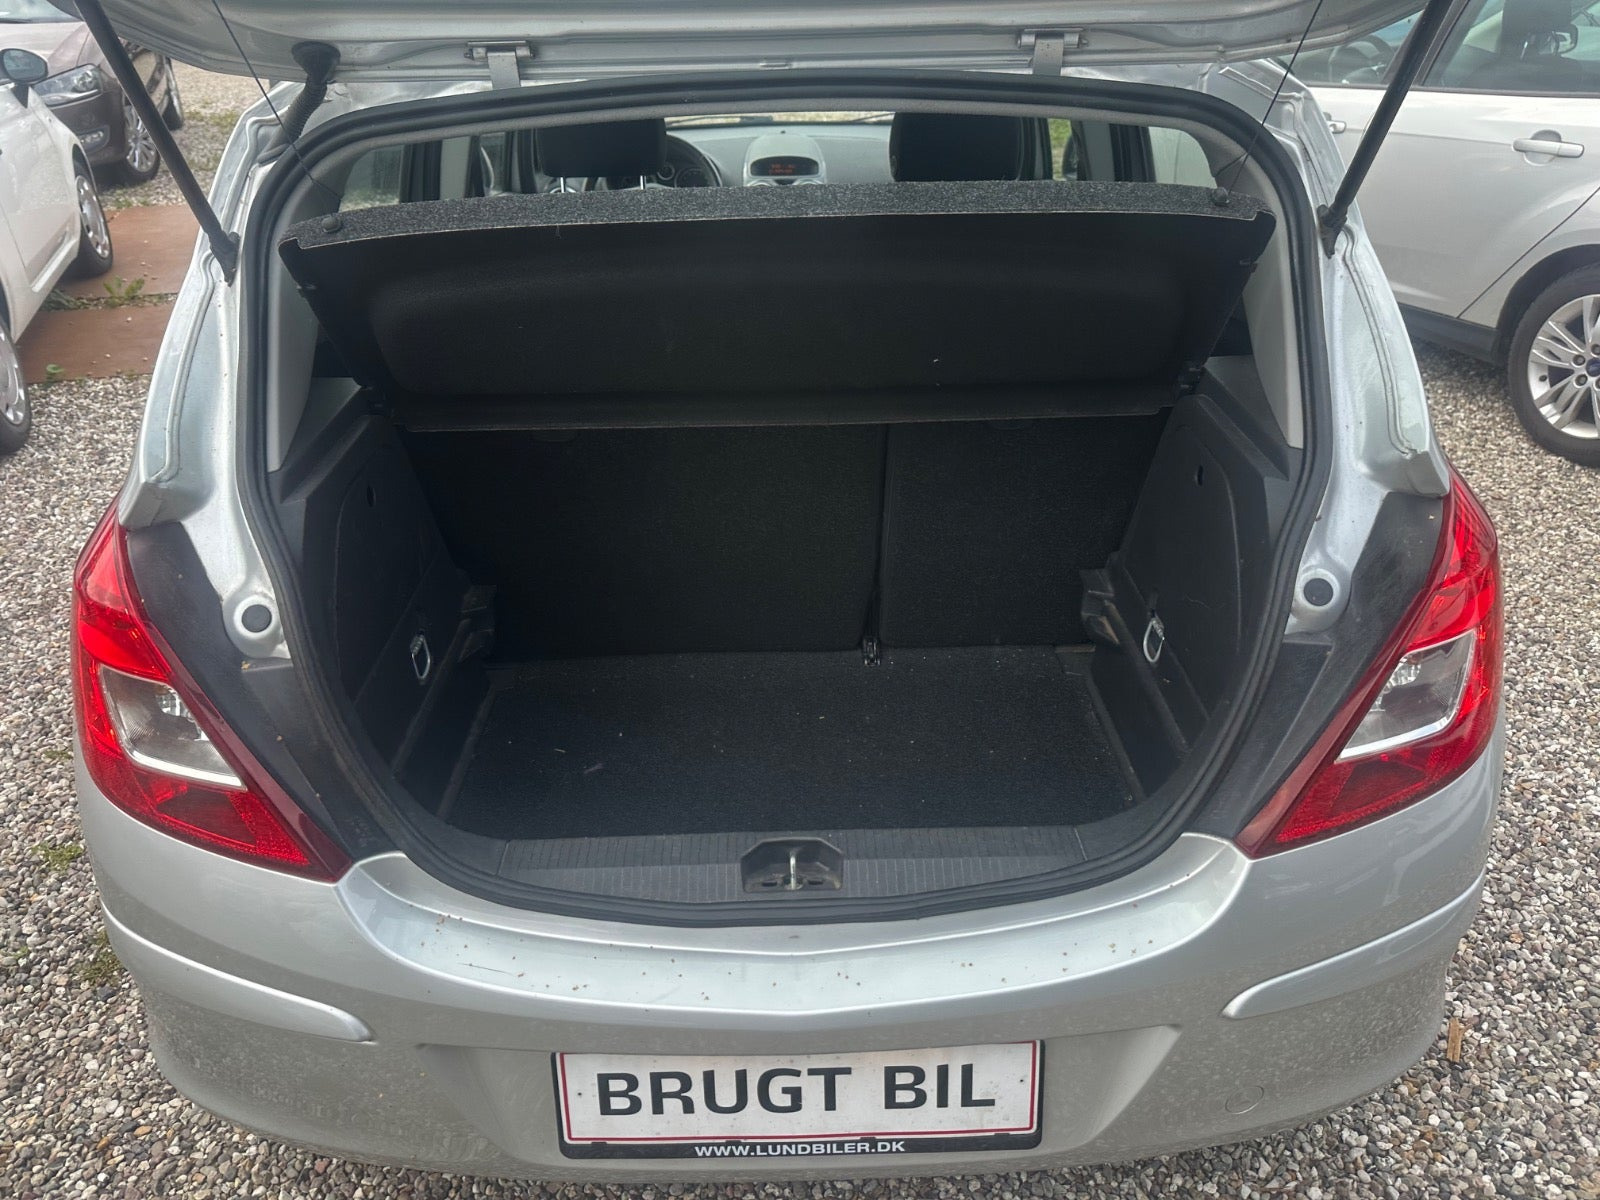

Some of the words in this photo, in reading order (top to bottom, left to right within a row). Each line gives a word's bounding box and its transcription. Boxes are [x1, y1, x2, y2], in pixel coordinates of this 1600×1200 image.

[596, 1067, 852, 1116] BRUGT
[884, 1063, 996, 1109] BIL
[694, 1141, 905, 1157] WWW.LUNDBILER.DK
